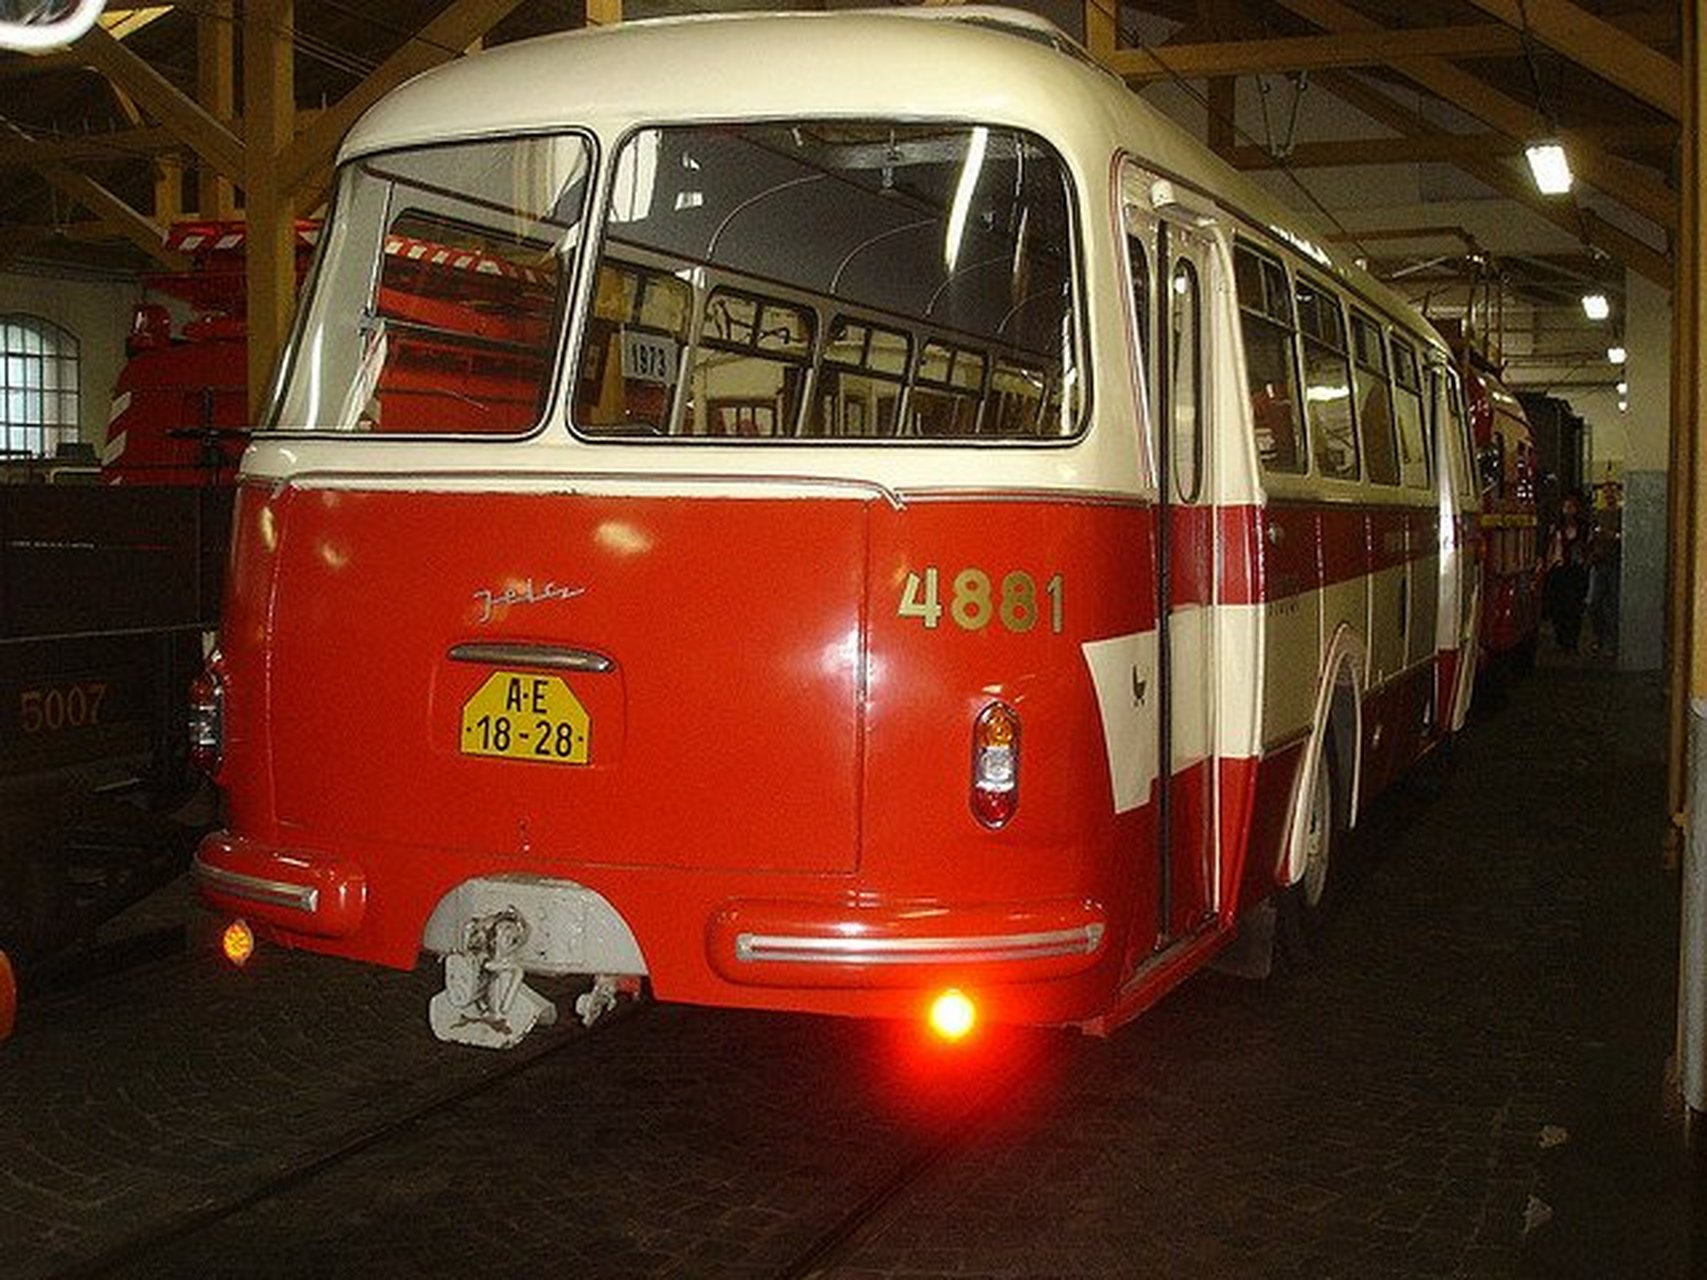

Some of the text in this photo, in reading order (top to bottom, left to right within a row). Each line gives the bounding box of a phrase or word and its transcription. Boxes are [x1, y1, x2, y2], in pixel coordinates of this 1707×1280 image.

[631, 343, 666, 377] 1973
[898, 567, 1063, 633] 4881
[20, 684, 107, 731] 5007
